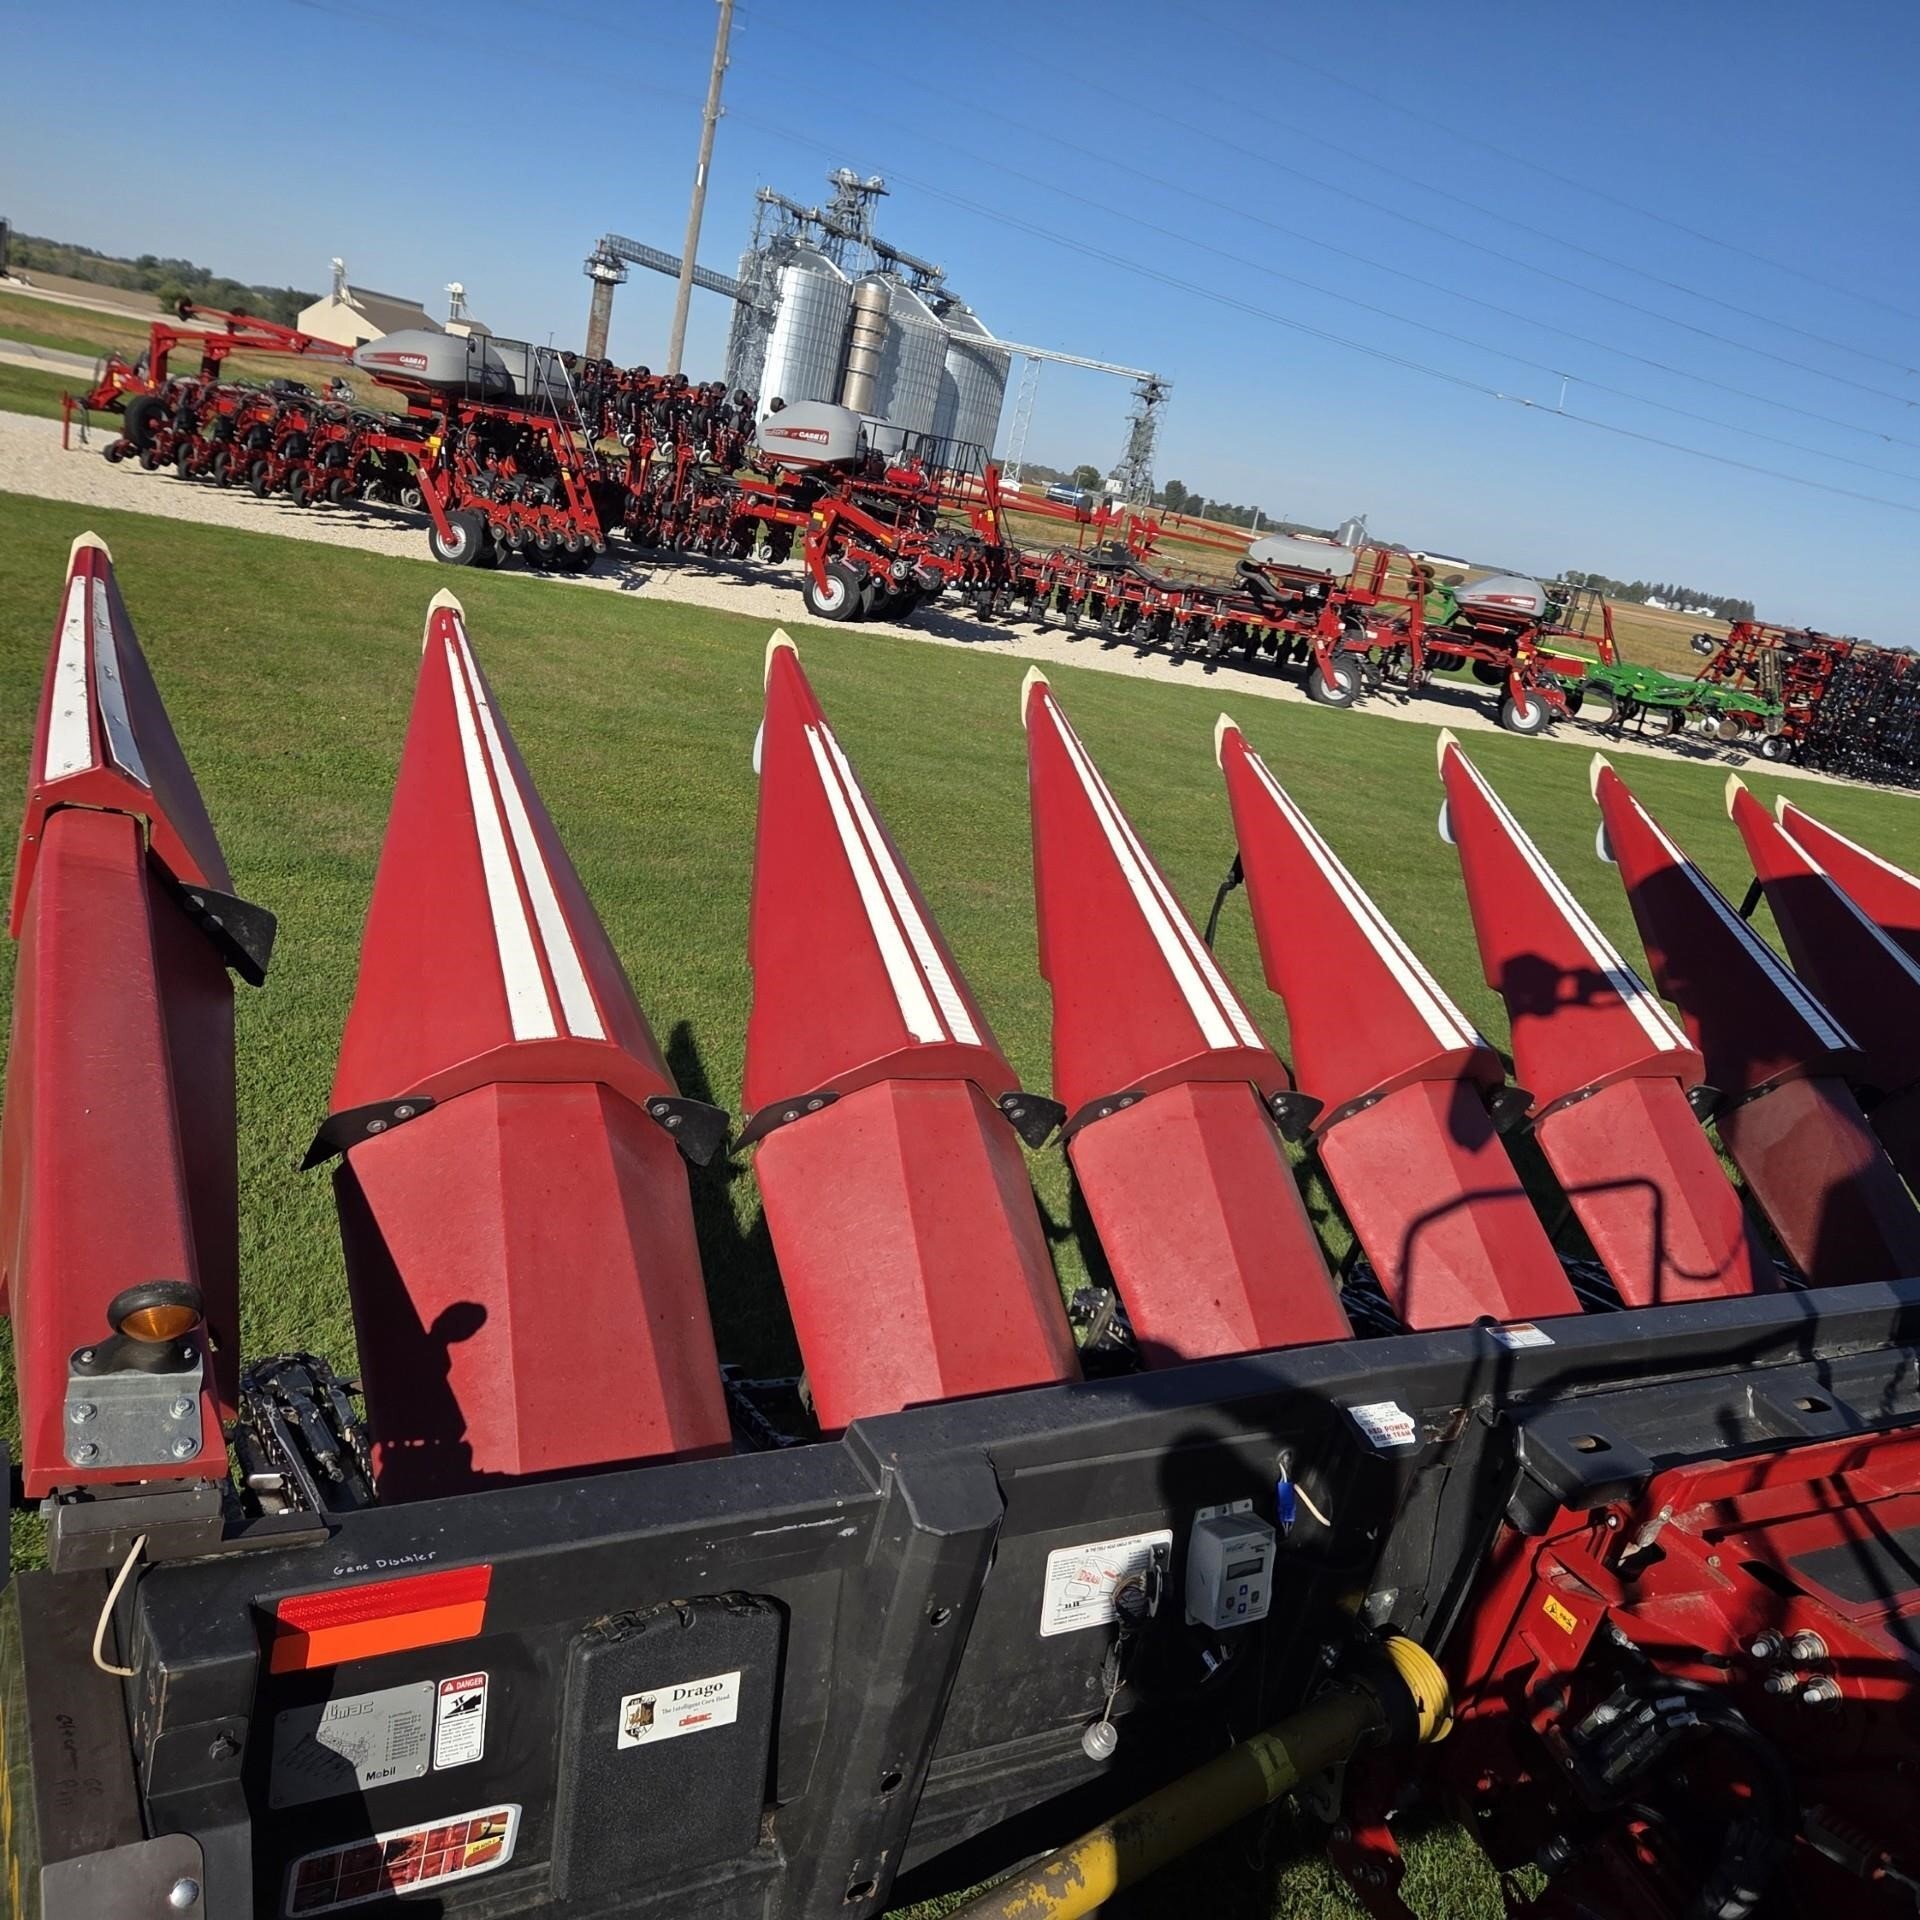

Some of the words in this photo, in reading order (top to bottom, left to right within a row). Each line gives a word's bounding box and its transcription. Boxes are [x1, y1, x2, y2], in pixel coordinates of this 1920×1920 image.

[1384, 1422, 1410, 1432] POWER
[1393, 1430, 1411, 1438] TEAM
[333, 1563, 369, 1575] Gene
[456, 1677, 483, 1690] DANGER
[672, 1683, 723, 1701] Drago
[366, 1766, 396, 1781] Mobil
